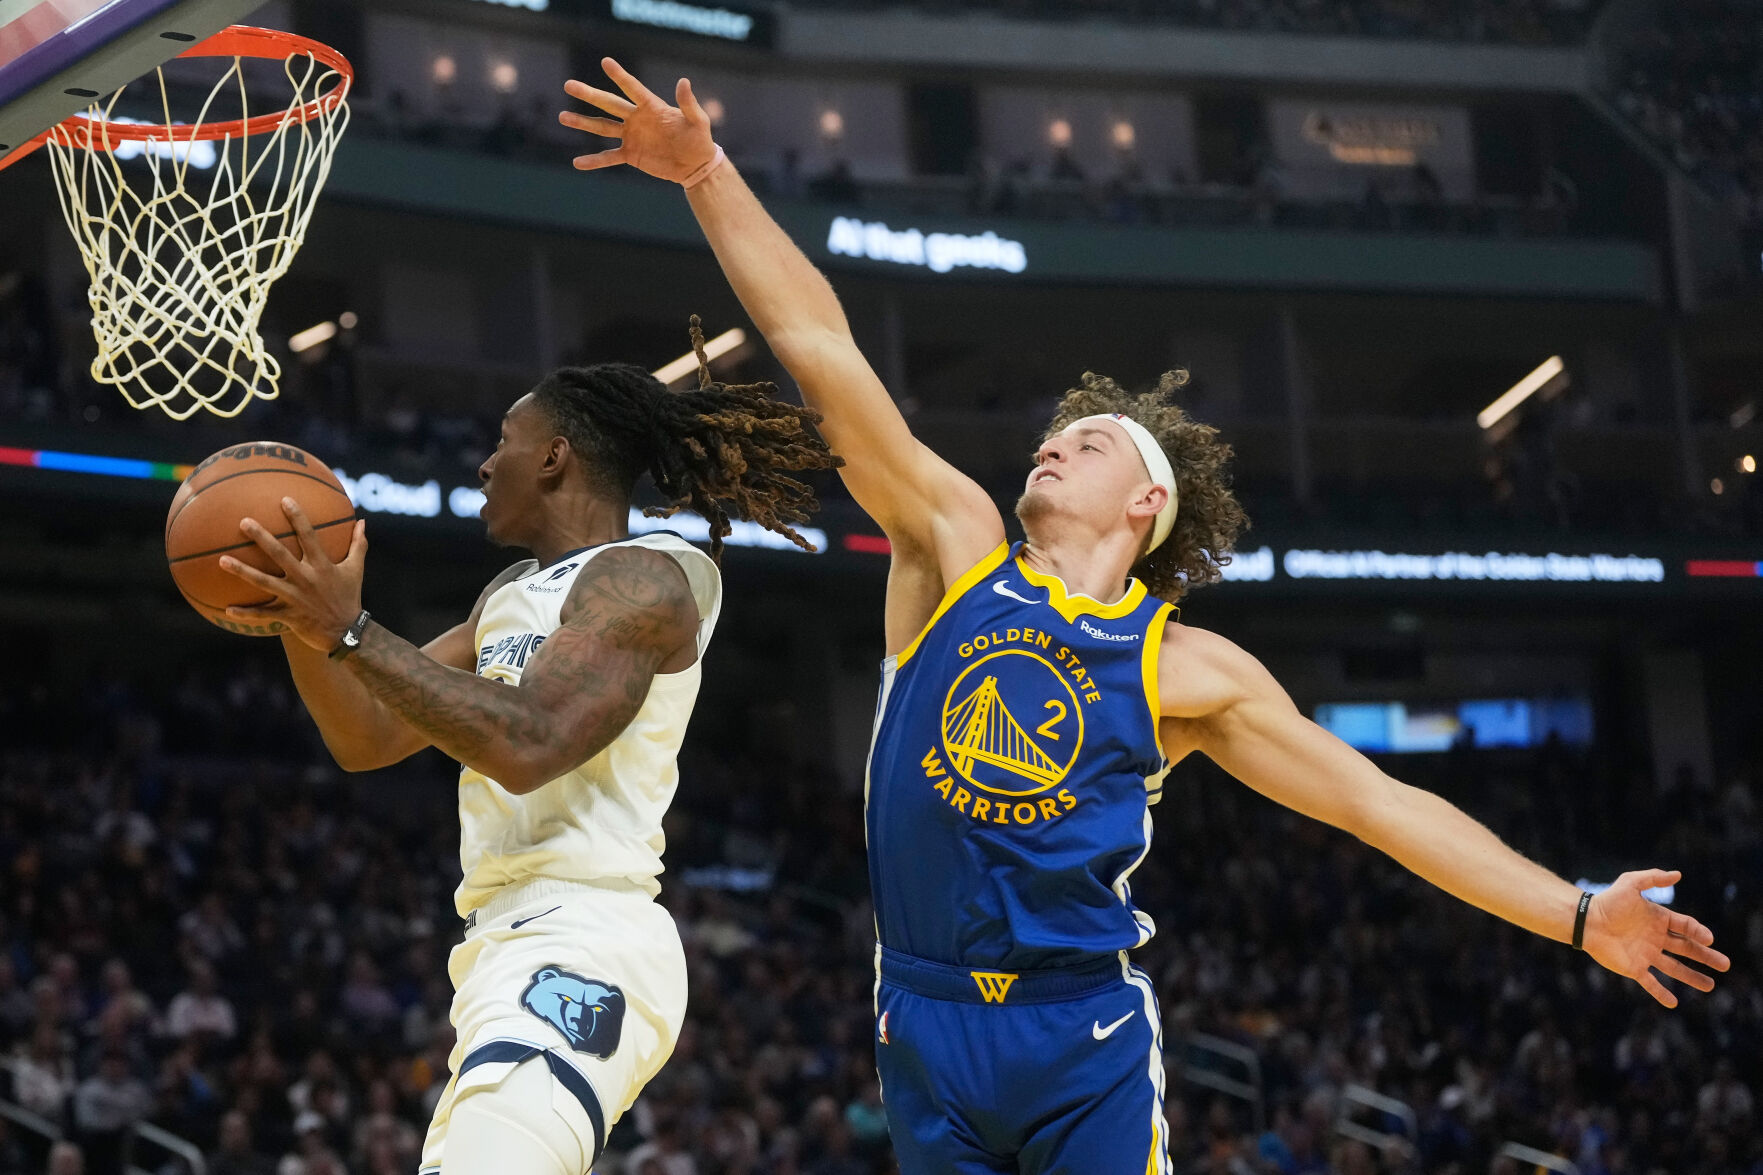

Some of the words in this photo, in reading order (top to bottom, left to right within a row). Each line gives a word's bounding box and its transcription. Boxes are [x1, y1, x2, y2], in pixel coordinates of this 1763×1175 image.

[1080, 620, 1139, 641] Rakuten
[958, 628, 1052, 658] GOLDEN
[1055, 647, 1102, 705] STATE
[1036, 699, 1068, 741] 2
[919, 746, 1078, 825] WARRIORS
